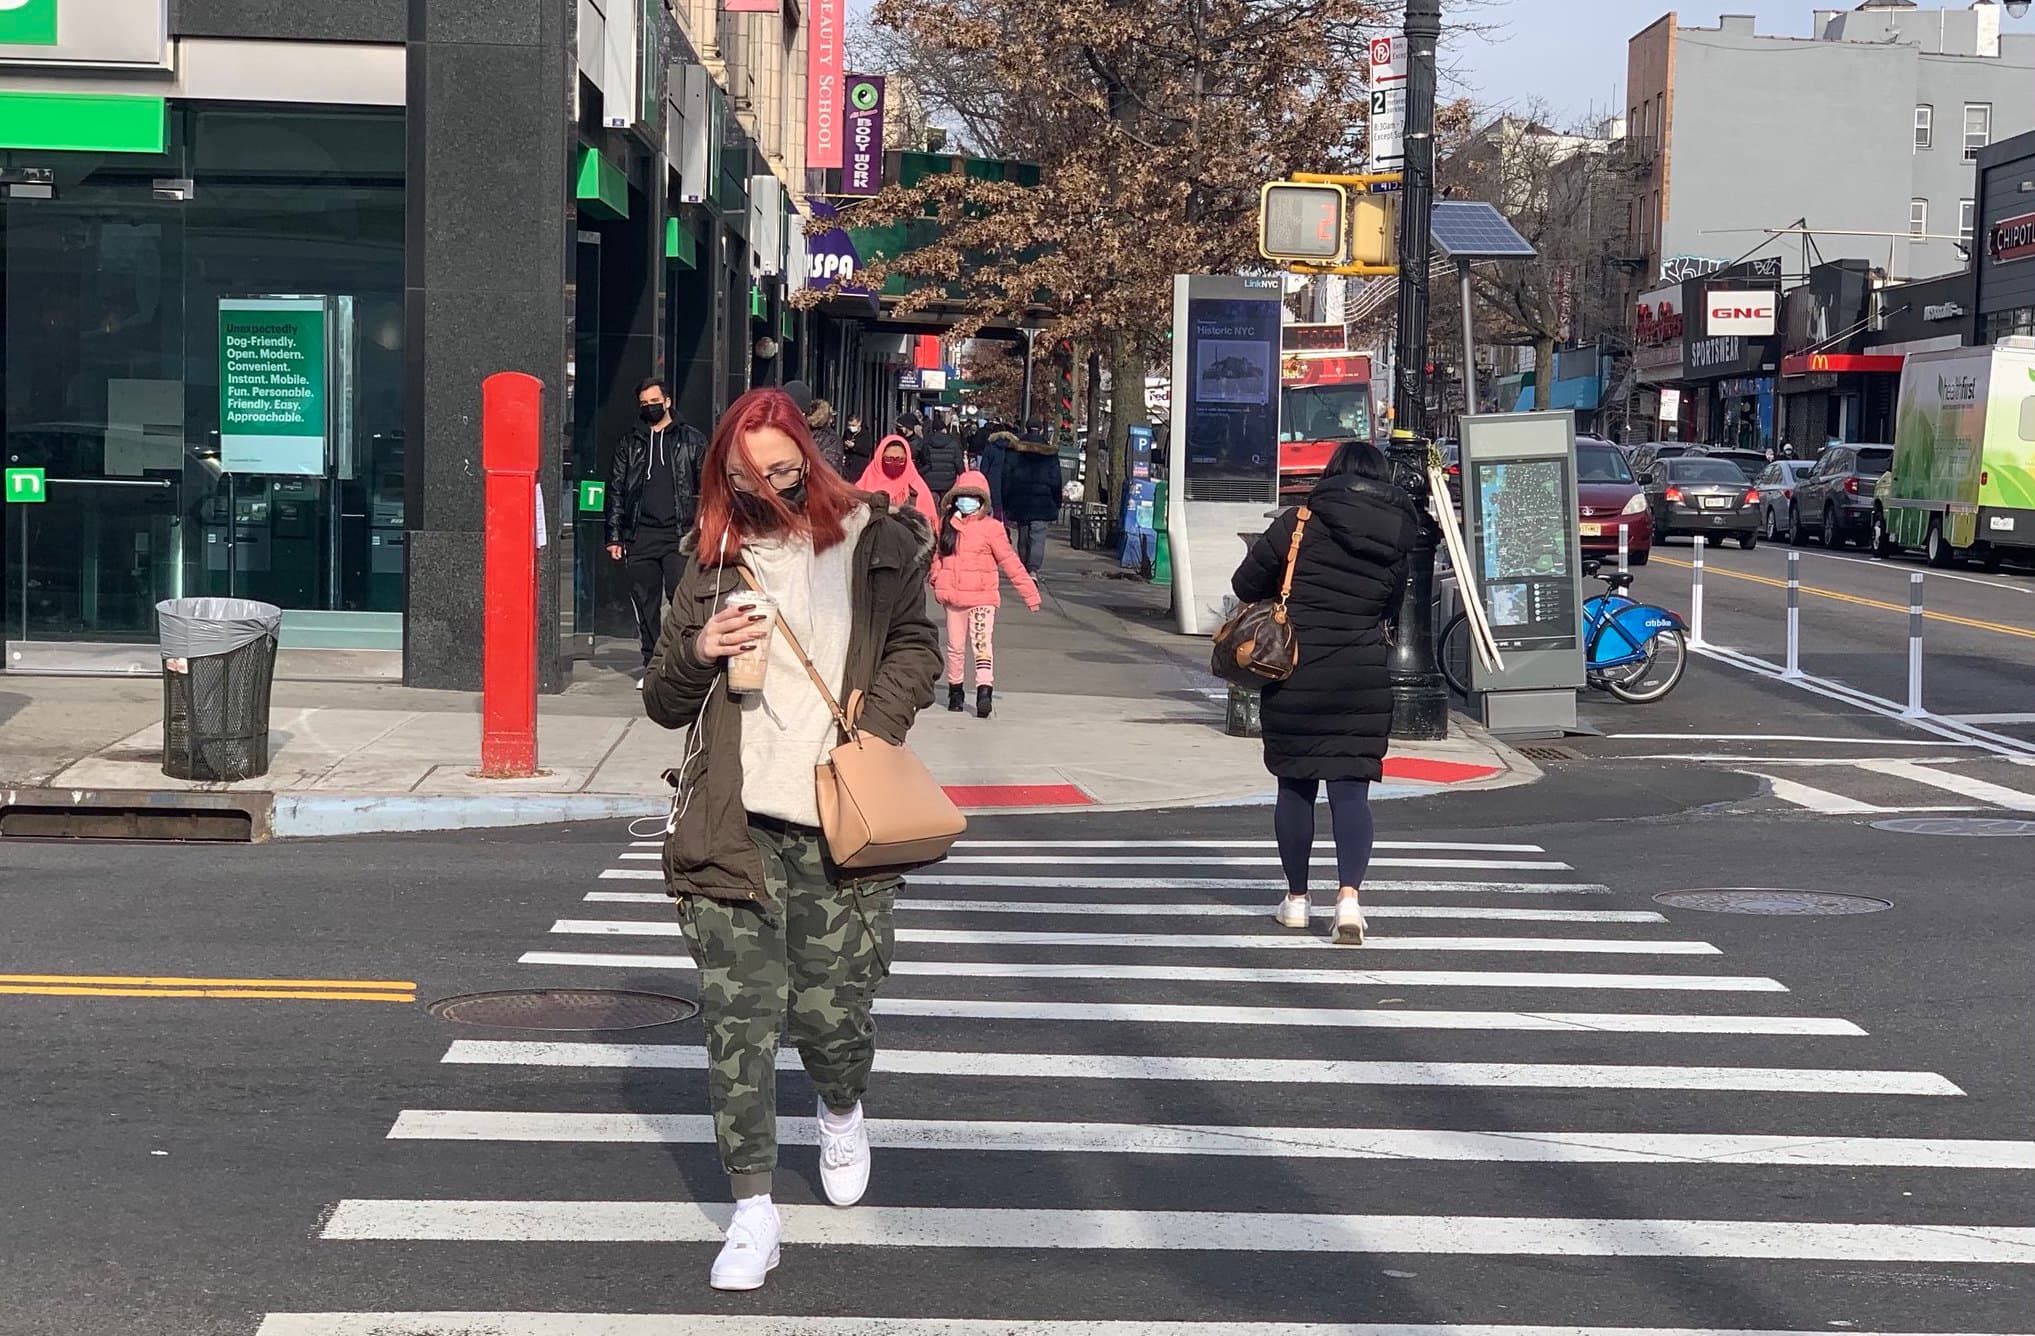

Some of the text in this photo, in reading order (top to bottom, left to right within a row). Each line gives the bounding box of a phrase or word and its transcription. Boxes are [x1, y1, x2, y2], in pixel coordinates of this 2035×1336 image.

[818, 0, 835, 155] EAUTY SCHOOL
[1373, 92, 1384, 113] 2
[855, 118, 872, 151] BODY
[853, 154, 870, 188] WORK
[1244, 280, 1278, 288] LinkNYC
[1712, 308, 1773, 319] GNC
[226, 323, 298, 335] Unexpectedly
[1197, 326, 1255, 336] Historic NYC
[226, 336, 297, 348] Dog-Friendly.
[226, 348, 304, 361] Open. Modern.
[1691, 336, 1740, 368] SPORTSWEAR
[227, 361, 291, 372] Convenient.
[228, 373, 310, 385] Instant. Mobile.
[228, 386, 315, 398] Fun. Personable.
[227, 399, 302, 411] Friendly. Easy.
[227, 411, 305, 423] Approachable.
